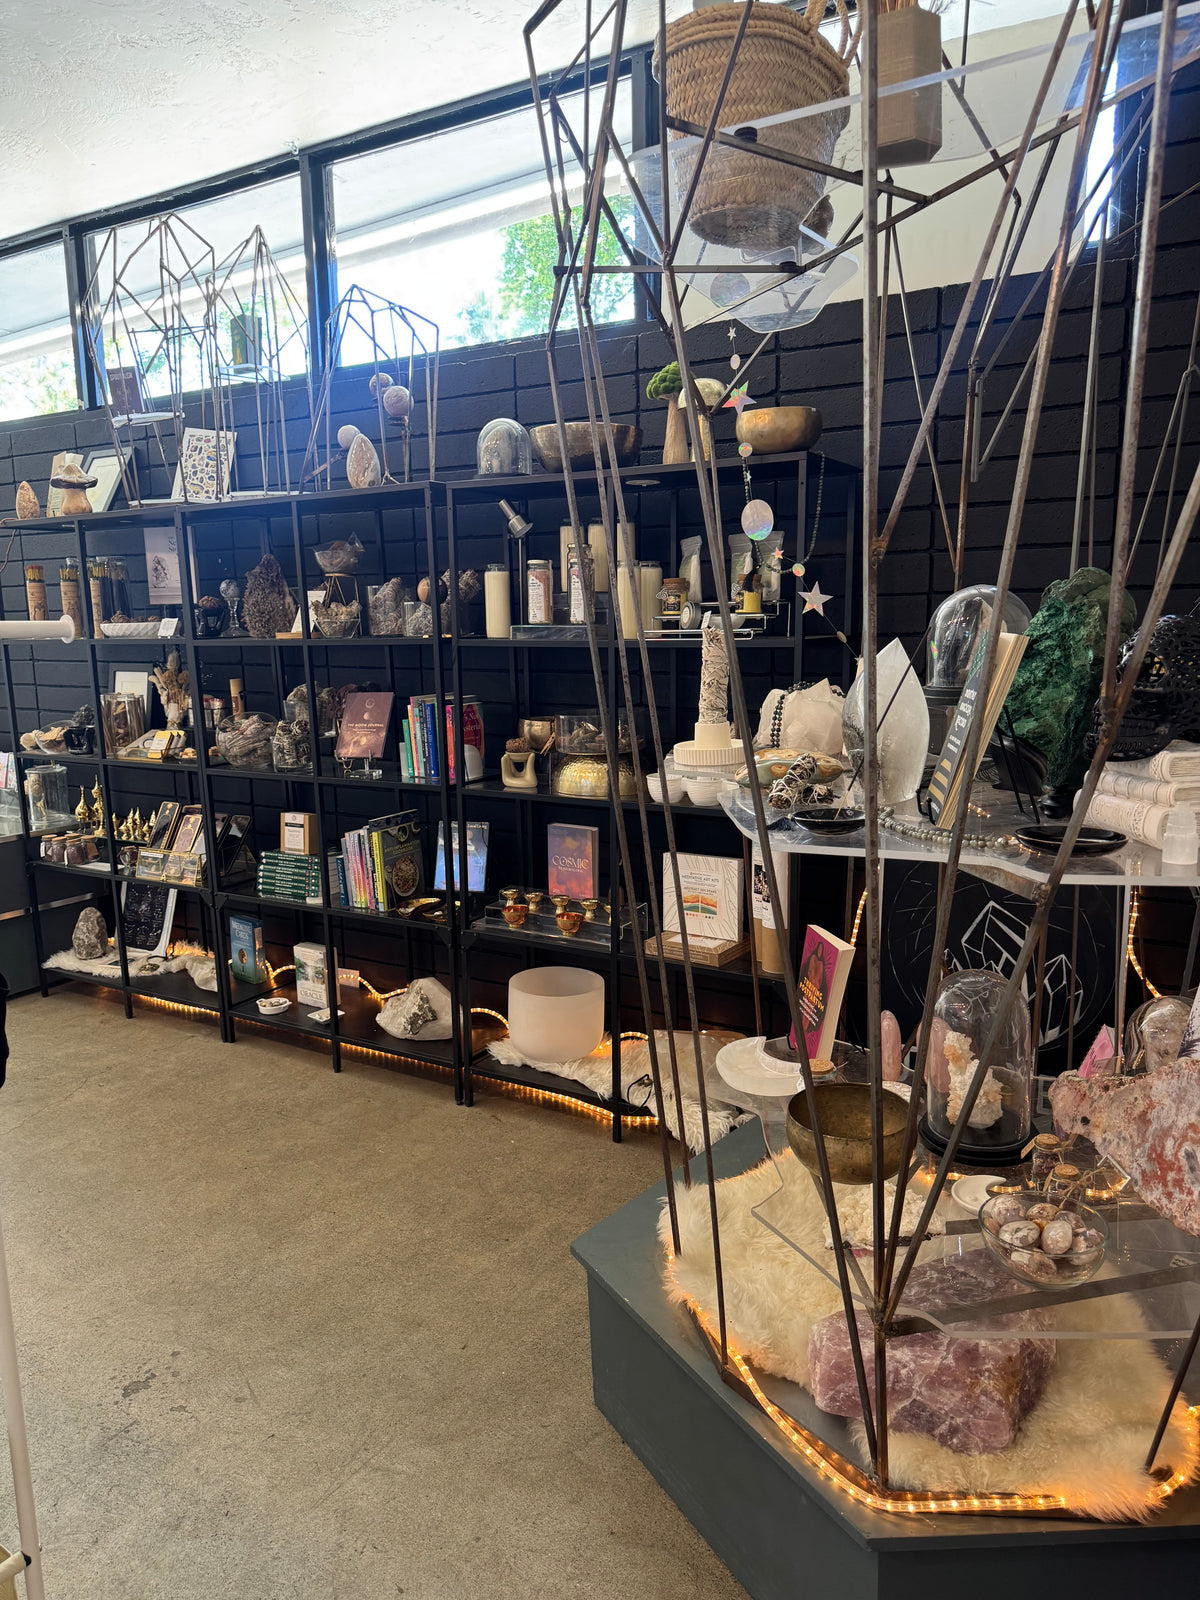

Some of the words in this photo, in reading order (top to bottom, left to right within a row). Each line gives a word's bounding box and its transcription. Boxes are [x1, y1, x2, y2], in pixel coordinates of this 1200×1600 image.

[552, 855, 589, 869] COSMIC
[299, 989, 323, 1000] ORACLE
[803, 976, 823, 1000] THRIVING
